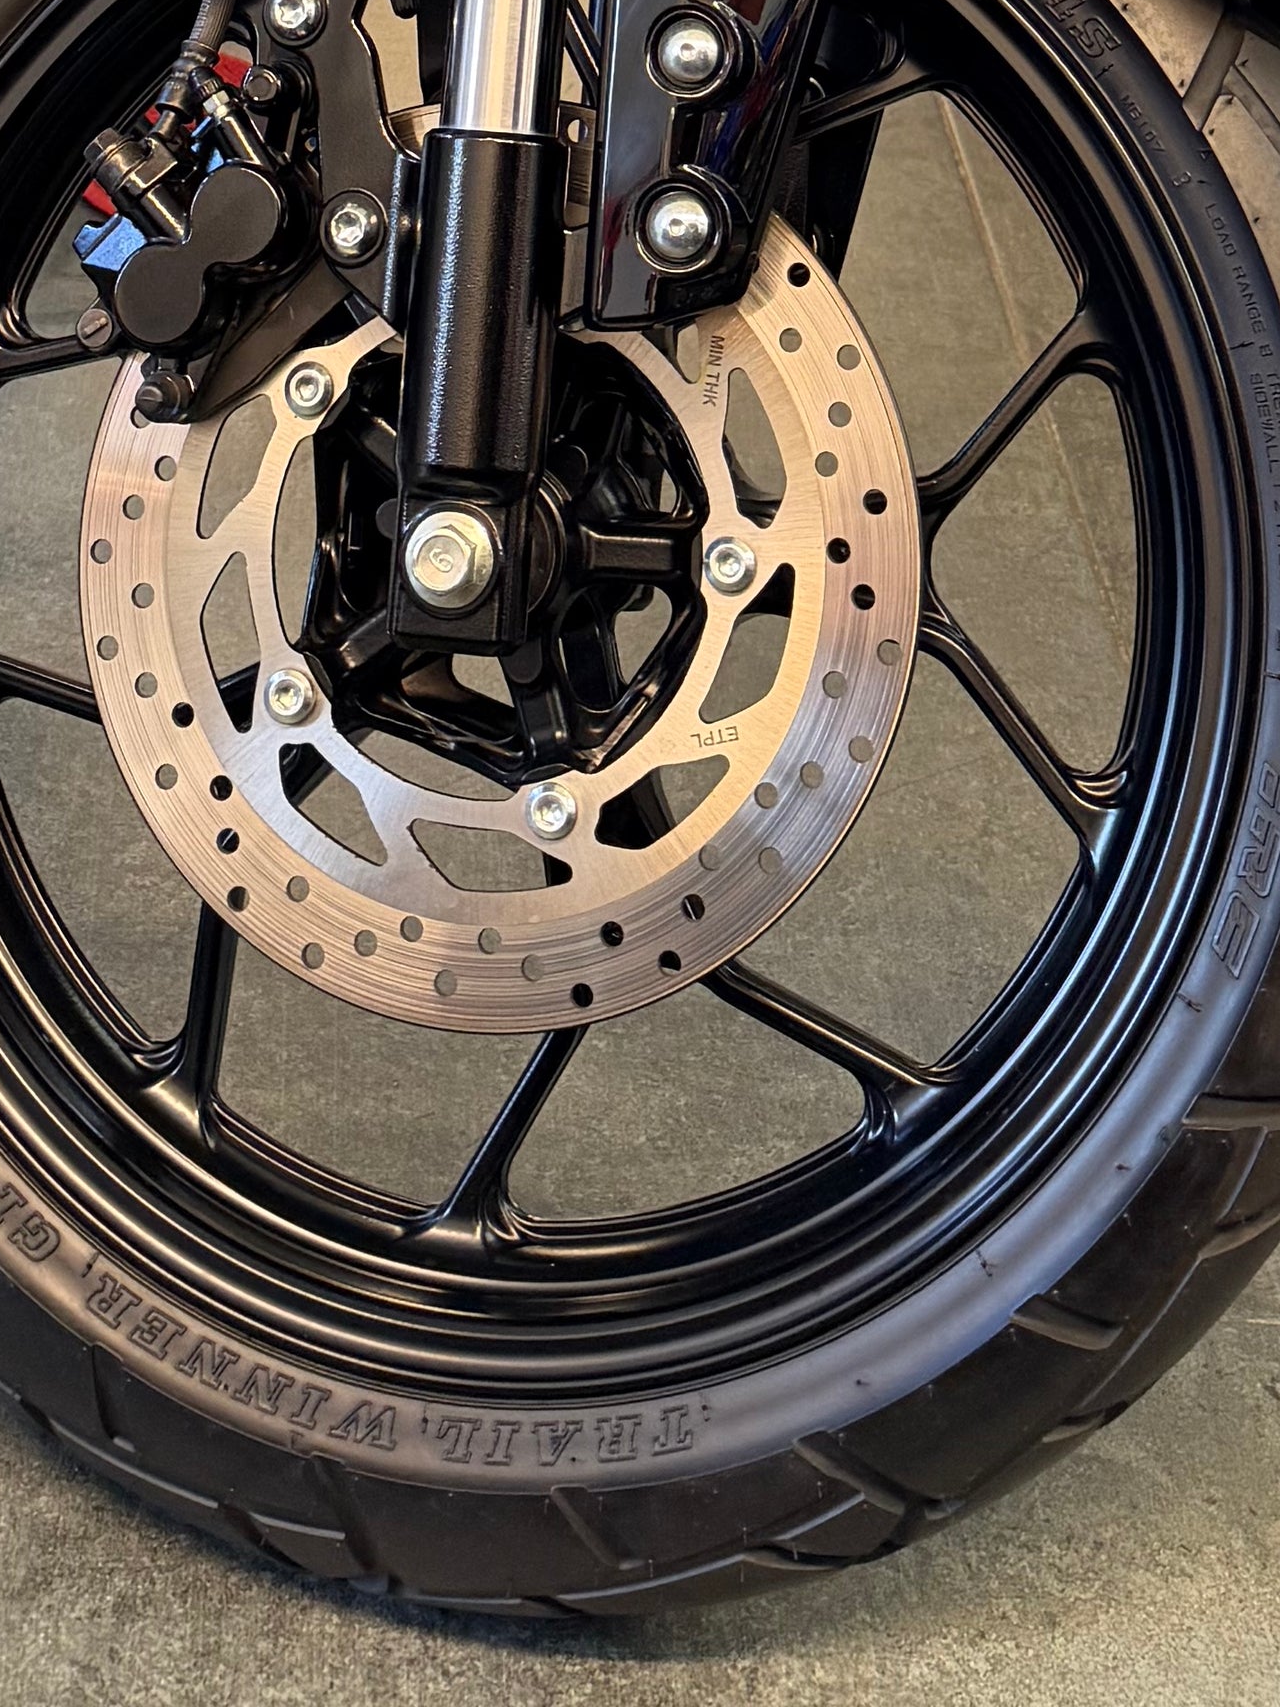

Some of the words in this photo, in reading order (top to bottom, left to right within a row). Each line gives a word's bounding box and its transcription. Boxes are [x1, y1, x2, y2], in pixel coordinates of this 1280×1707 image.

[1205, 202, 1238, 257] LOAD
[1232, 264, 1268, 336] RANGE
[710, 334, 726, 367] MIN
[702, 372, 721, 407] THK
[690, 725, 739, 748] ETPL
[84, 1274, 399, 1452] WINNER
[434, 1404, 696, 1467] TRAIL
